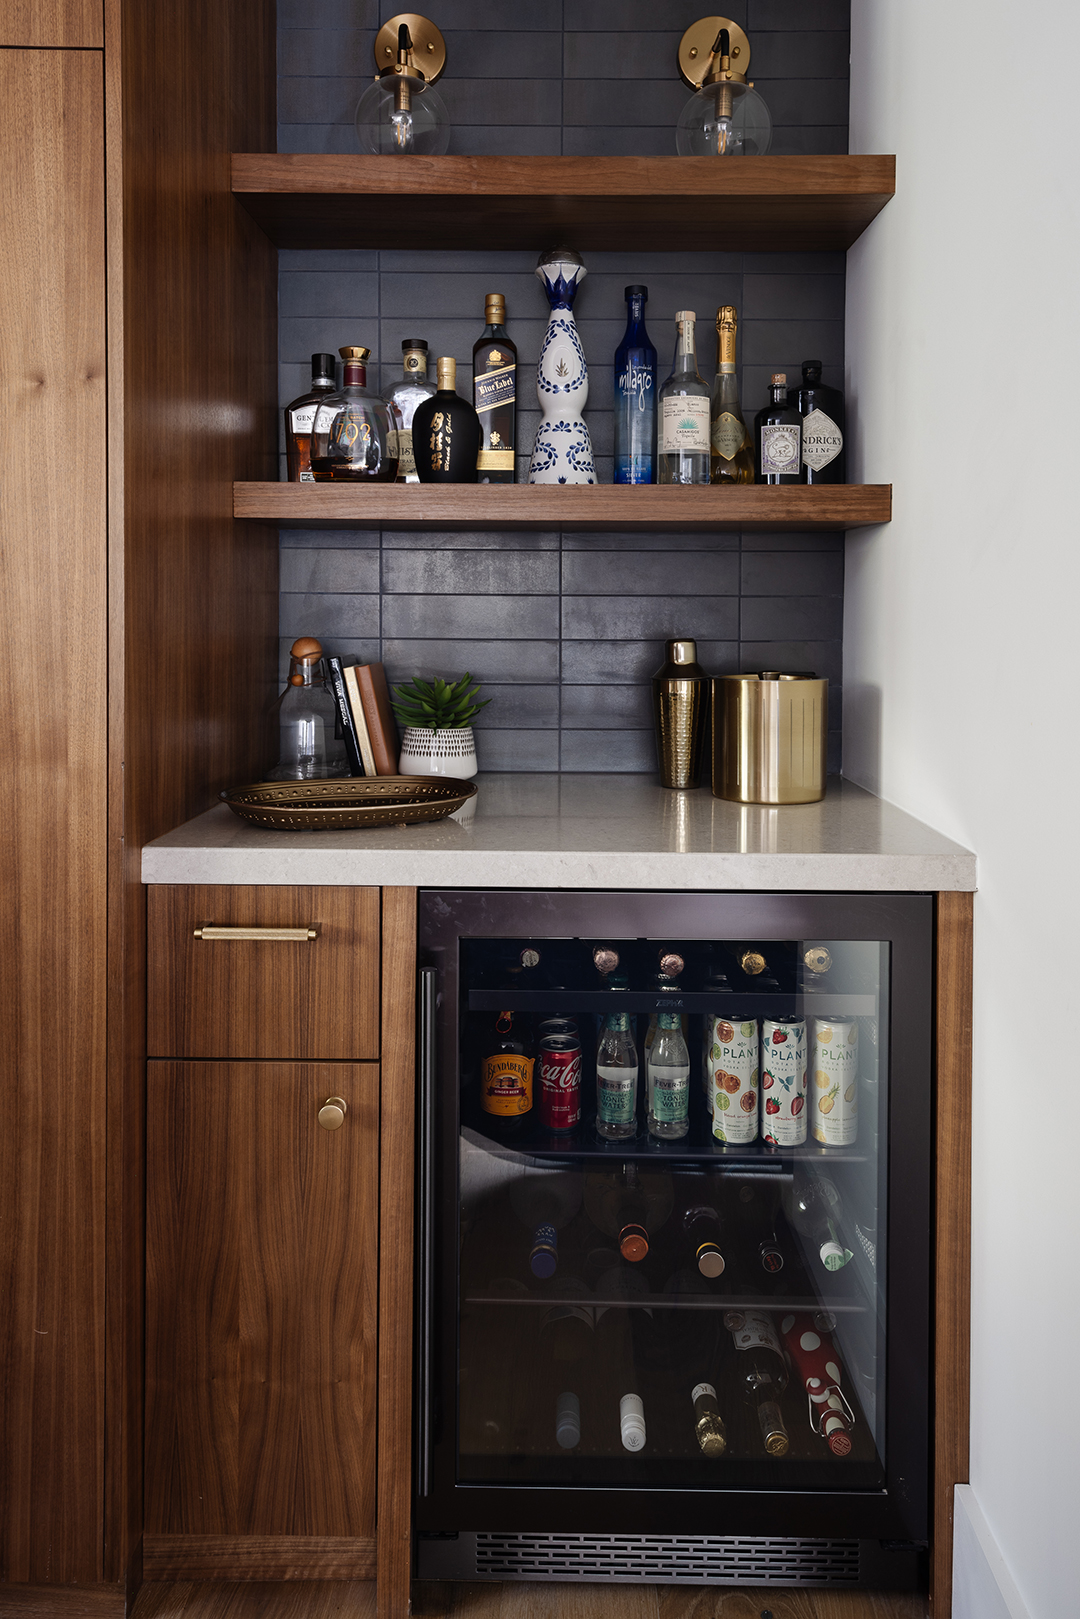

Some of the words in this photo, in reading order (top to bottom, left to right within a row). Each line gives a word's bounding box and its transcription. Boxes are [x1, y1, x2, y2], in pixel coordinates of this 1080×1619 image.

[478, 384, 495, 395] Blue
[493, 377, 513, 390] Label
[619, 359, 652, 412] milagro
[445, 412, 453, 434] Gold
[330, 423, 371, 448] 1792
[445, 436, 451, 444] &
[335, 680, 343, 697] VIVA
[655, 999, 684, 1007] ZEPHYR
[723, 1046, 758, 1059] PLANT
[771, 1048, 807, 1061] PLANT
[822, 1048, 857, 1061] PLANT
[484, 1061, 530, 1083] BUNDABERG
[603, 1094, 626, 1103] TONIC
[663, 1094, 686, 1102] TONIC
